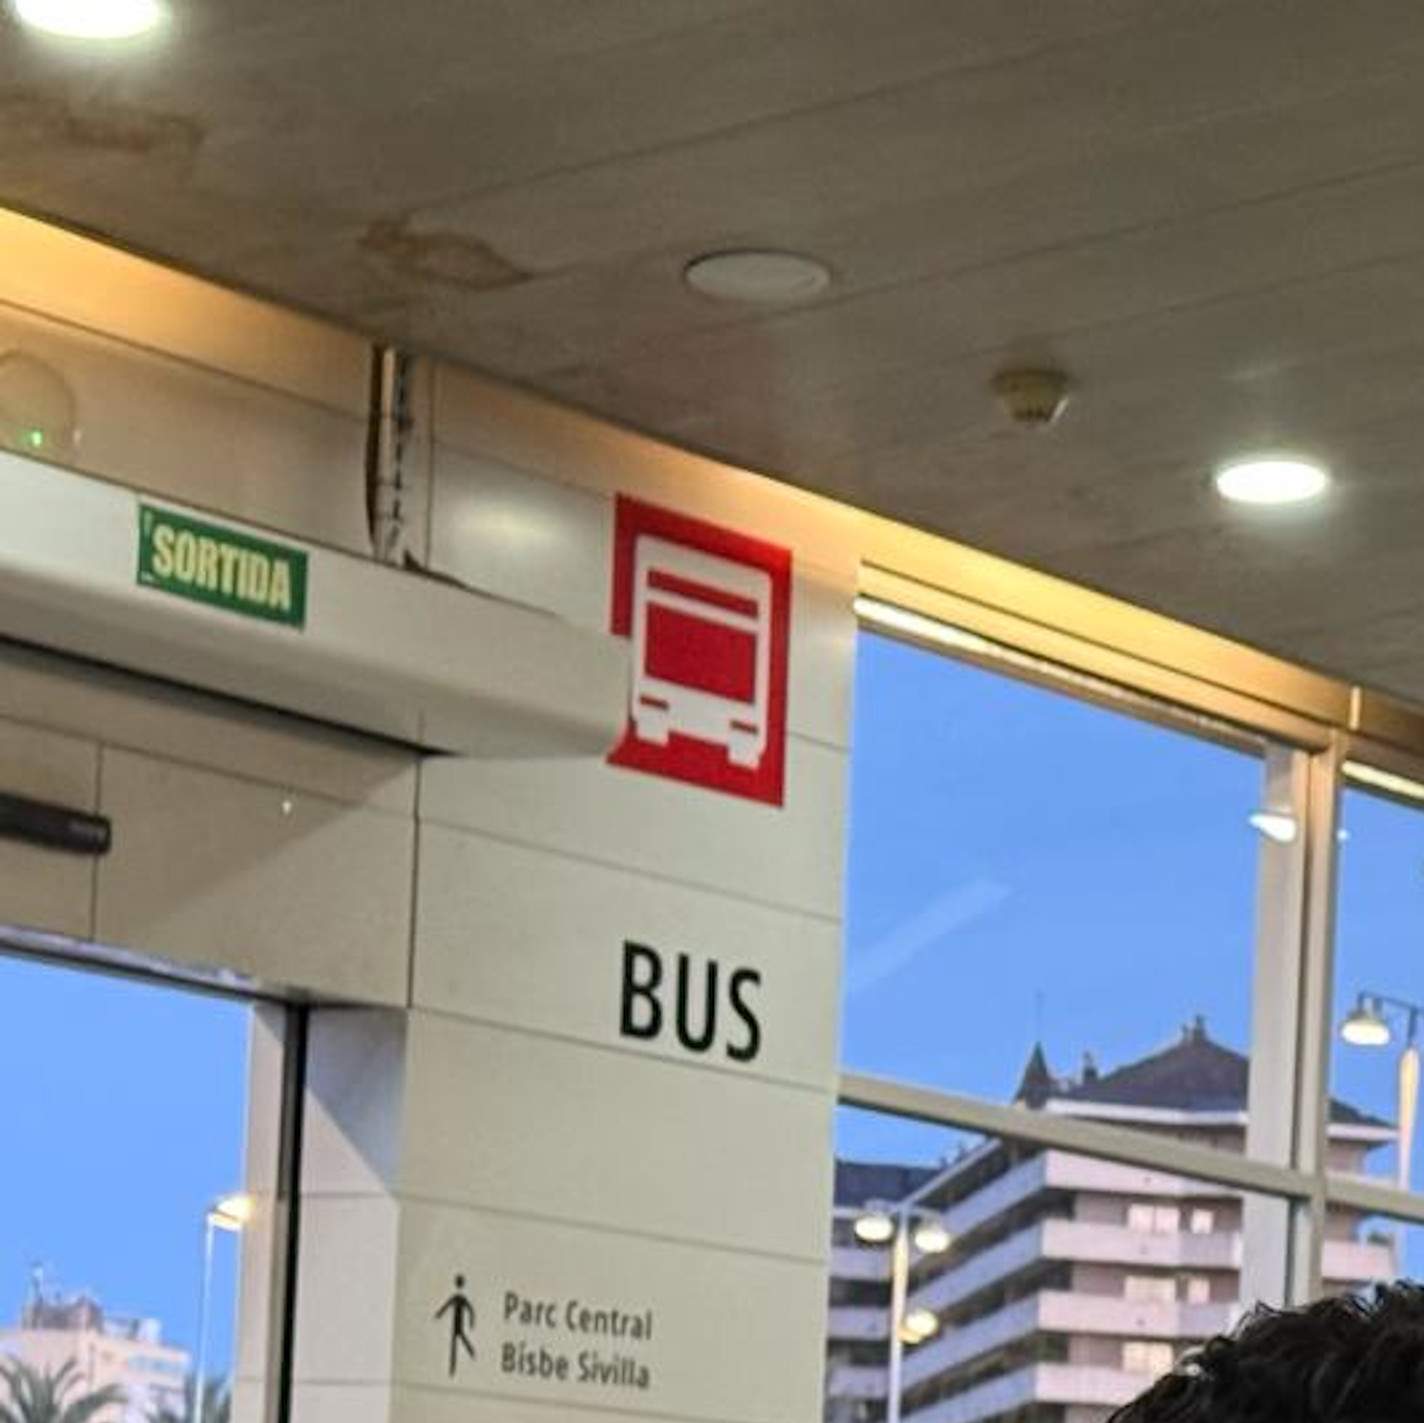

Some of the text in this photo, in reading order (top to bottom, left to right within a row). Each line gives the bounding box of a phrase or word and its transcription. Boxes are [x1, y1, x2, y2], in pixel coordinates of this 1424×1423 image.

[152, 523, 292, 611] SORTIDA
[619, 940, 764, 1062] BUS
[504, 1291, 653, 1340] Parc Central
[502, 1341, 650, 1390] Bisbe Sivilla
